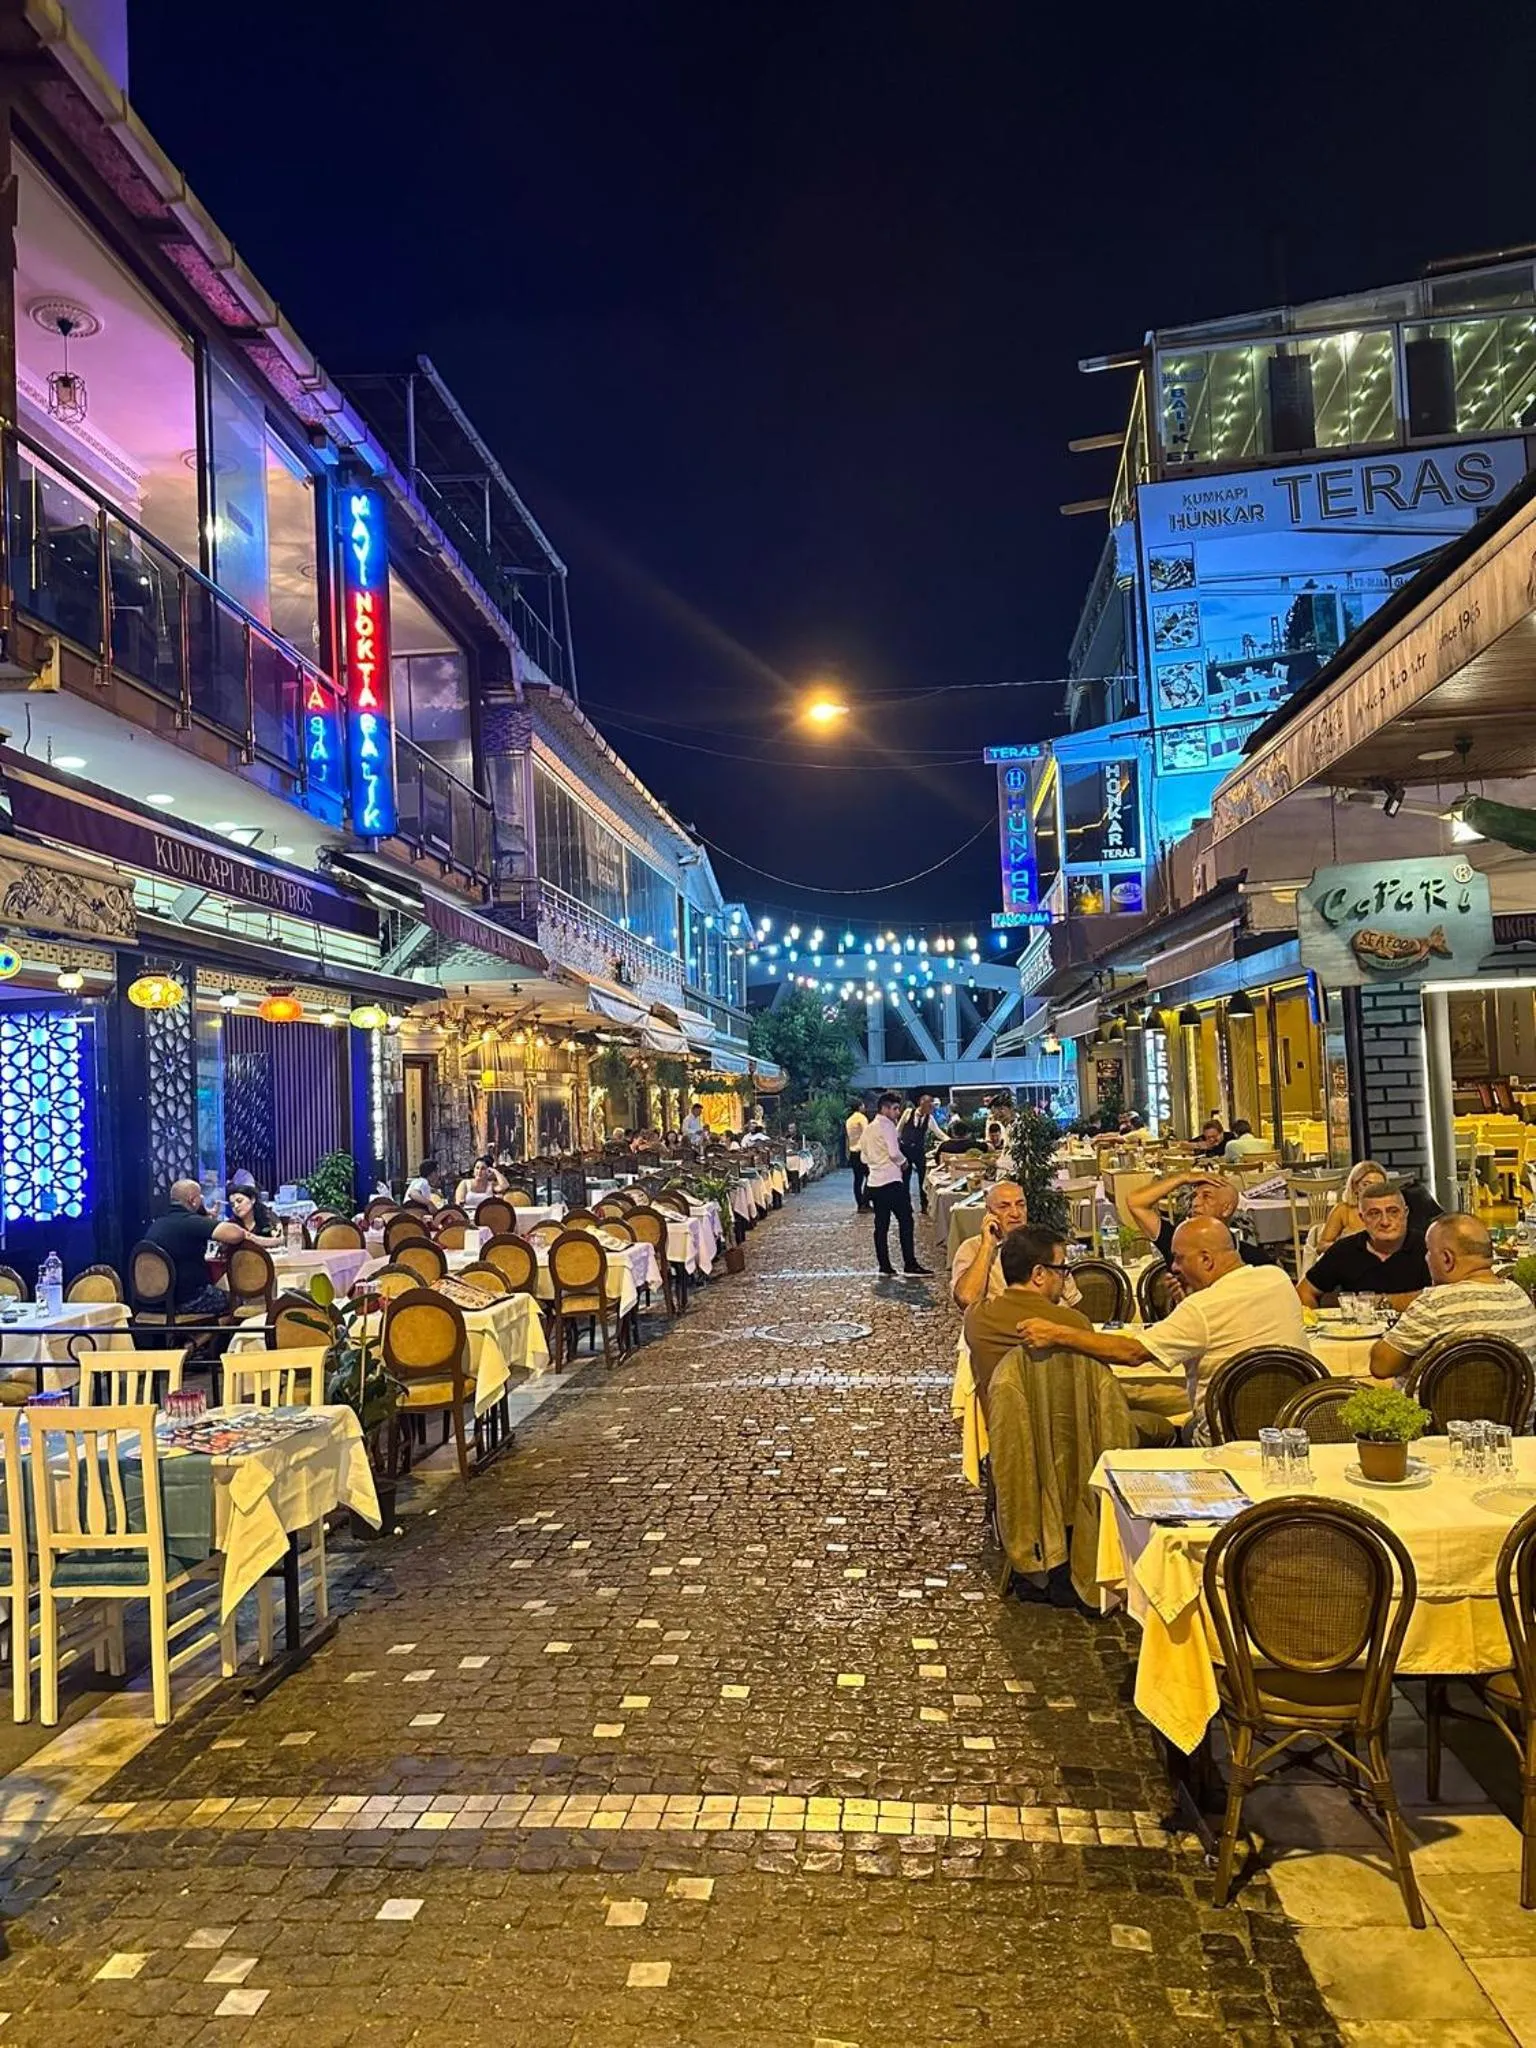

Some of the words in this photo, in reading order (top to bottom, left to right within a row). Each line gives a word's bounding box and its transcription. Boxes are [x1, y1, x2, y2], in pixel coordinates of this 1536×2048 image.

[1169, 504, 1265, 532] HÜNKAR
[1273, 452, 1497, 524] TERAS
[355, 592, 377, 707] NOKTA
[360, 713, 381, 829] BALIK
[990, 746, 1040, 759] TERAS
[153, 835, 236, 891] KUMKAPI
[239, 869, 314, 915] ALBATROS
[1102, 847, 1136, 858] TERAS
[1156, 1034, 1171, 1120] TERAS
